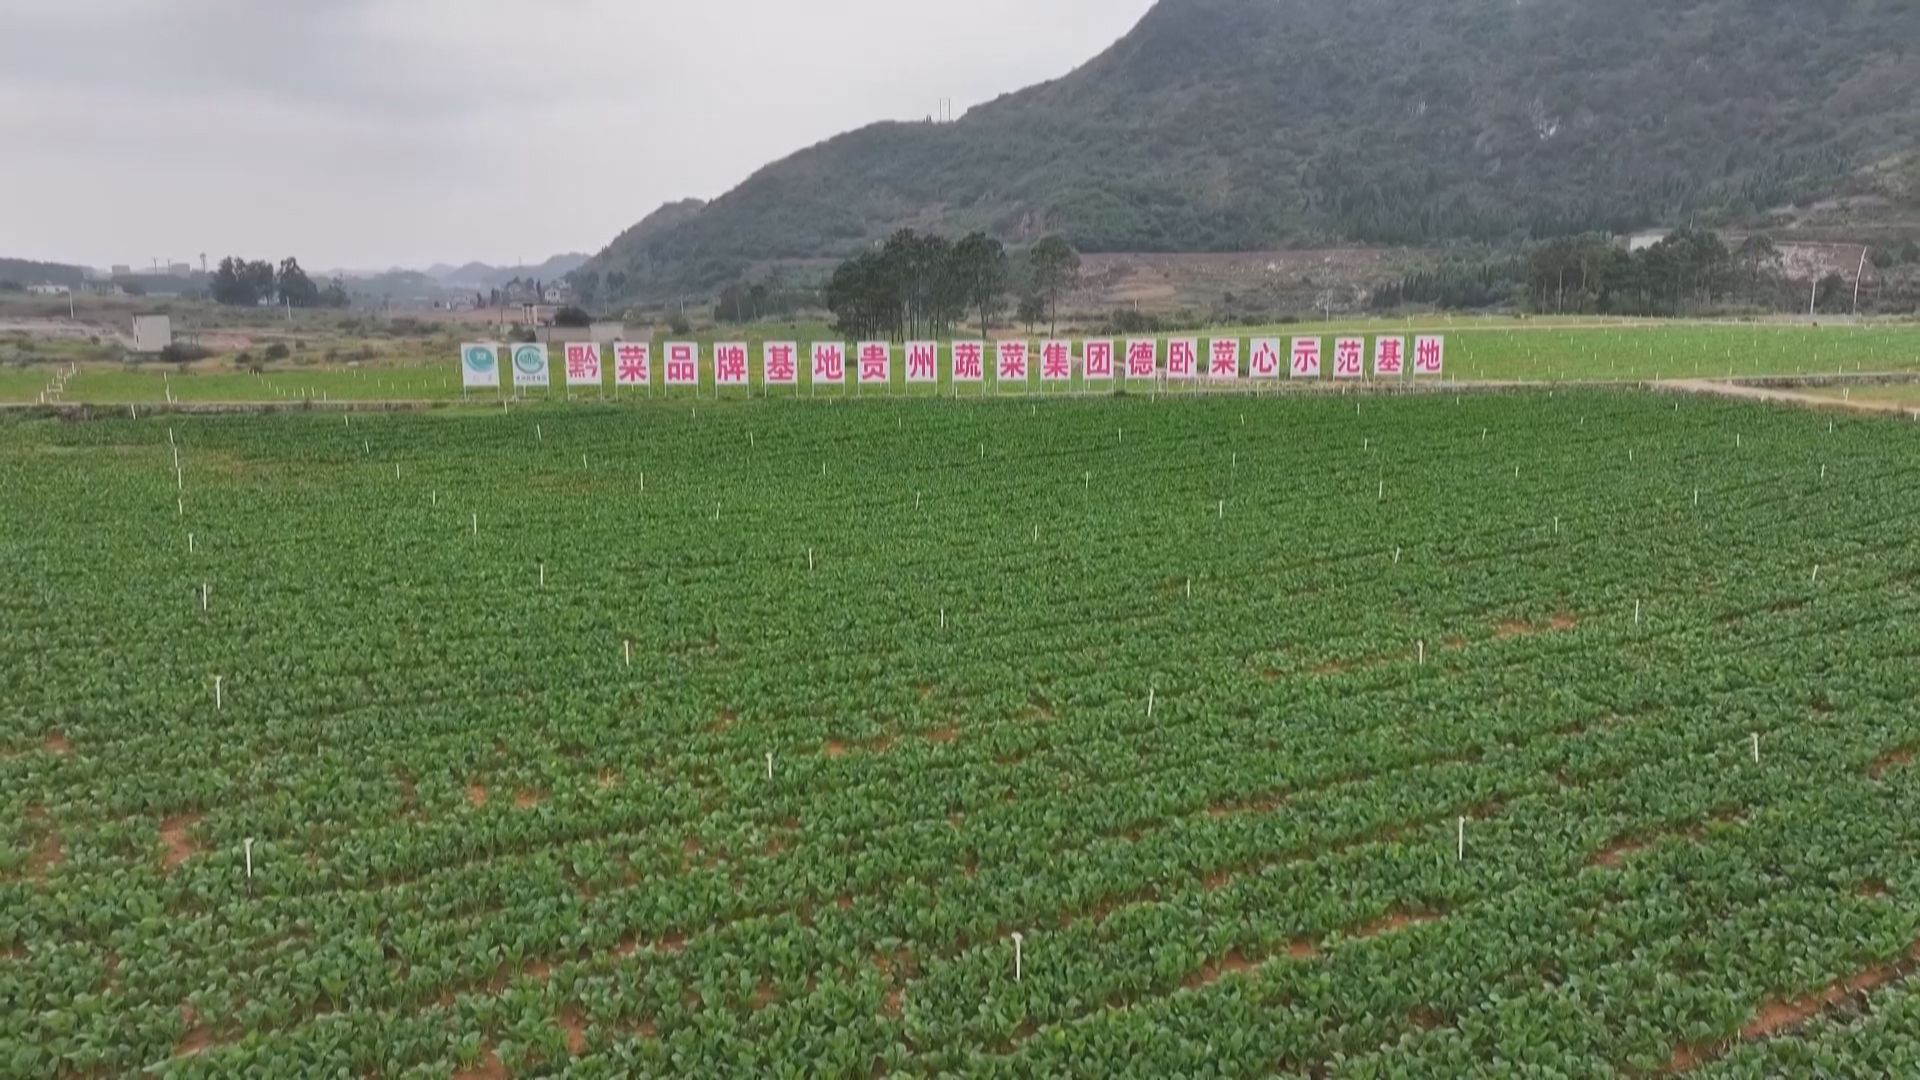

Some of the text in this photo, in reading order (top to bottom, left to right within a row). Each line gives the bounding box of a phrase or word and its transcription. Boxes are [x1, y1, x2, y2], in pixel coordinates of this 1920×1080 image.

[566, 338, 1441, 381] 黔菜品牌基地贵州蔬菜集团德卧菜心示范基地
